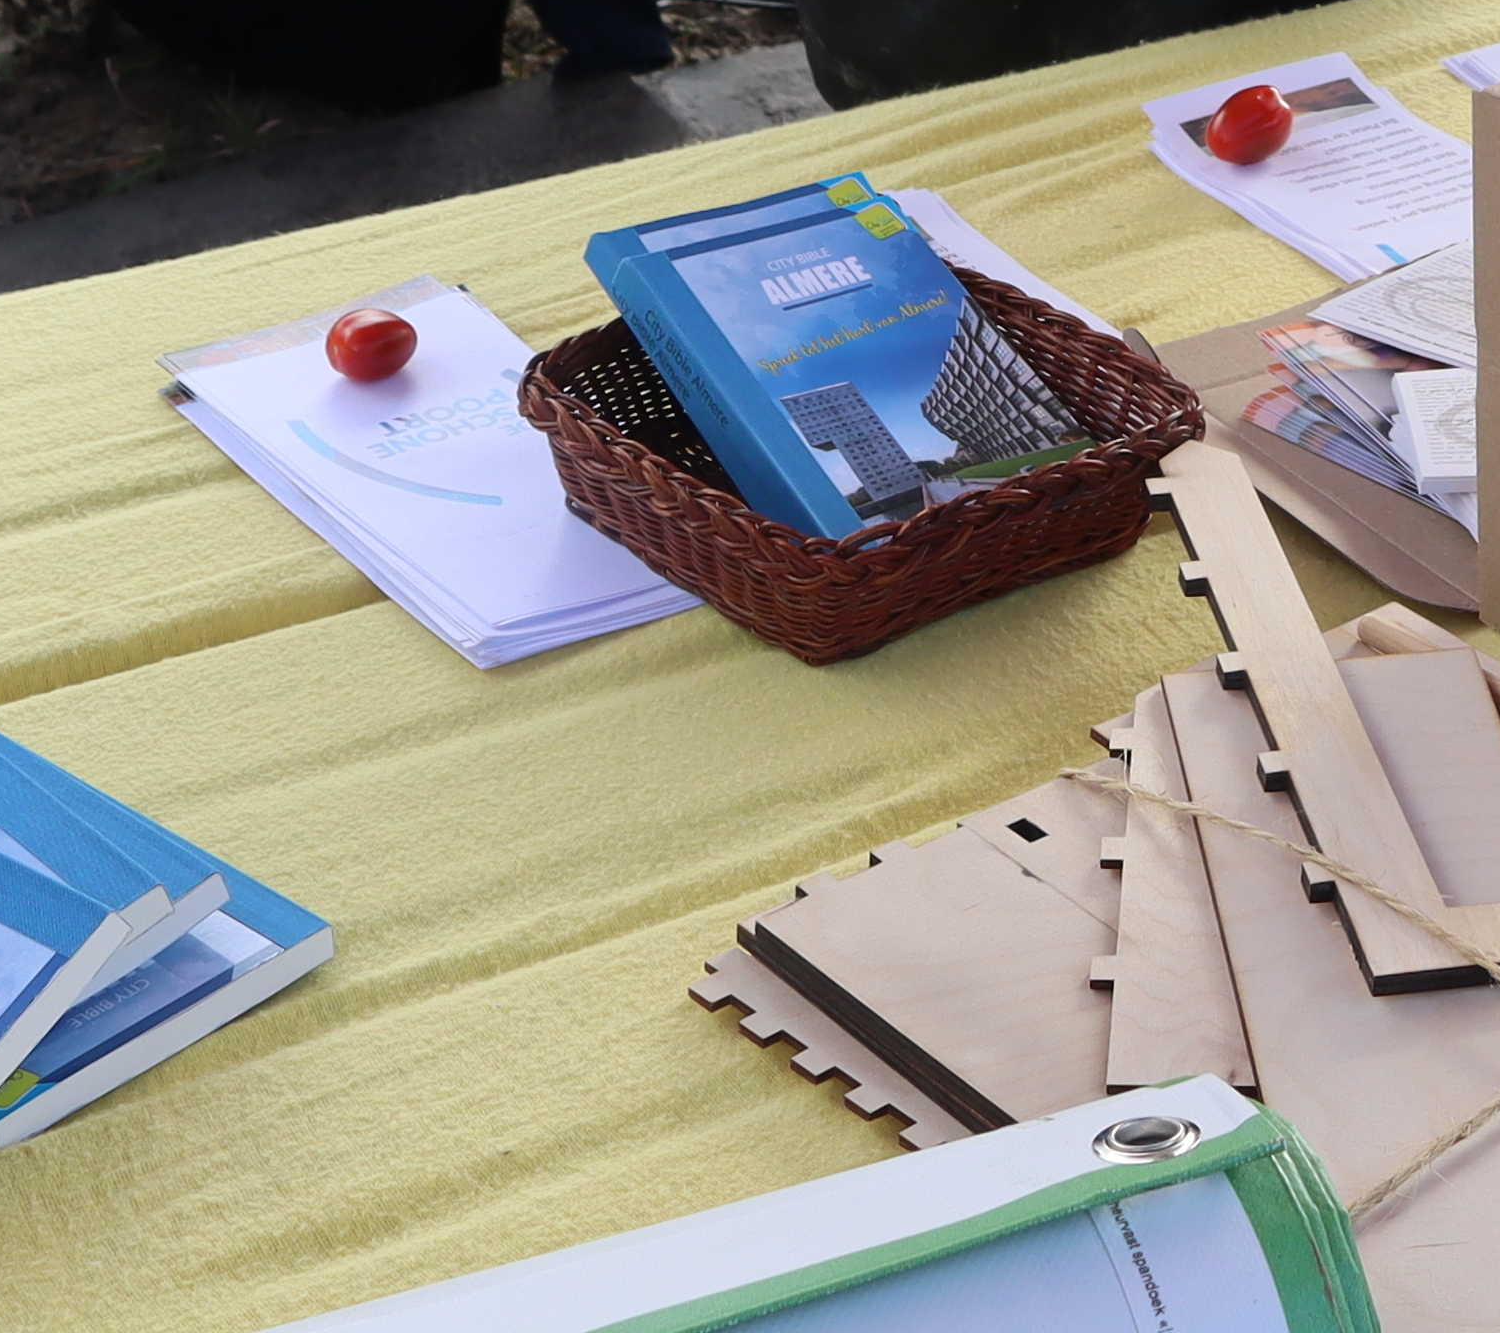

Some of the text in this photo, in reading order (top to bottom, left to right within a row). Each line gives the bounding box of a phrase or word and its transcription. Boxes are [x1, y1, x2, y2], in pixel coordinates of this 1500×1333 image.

[759, 256, 873, 306] ALMERE
[766, 247, 832, 272] CITY BIBLE
[644, 308, 730, 430] City Bible Almere
[366, 406, 518, 461] SCHONE
[379, 388, 512, 438] POORT
[69, 977, 151, 1030] CITY BIBLE
[1130, 1250, 1167, 1318] spandoek
